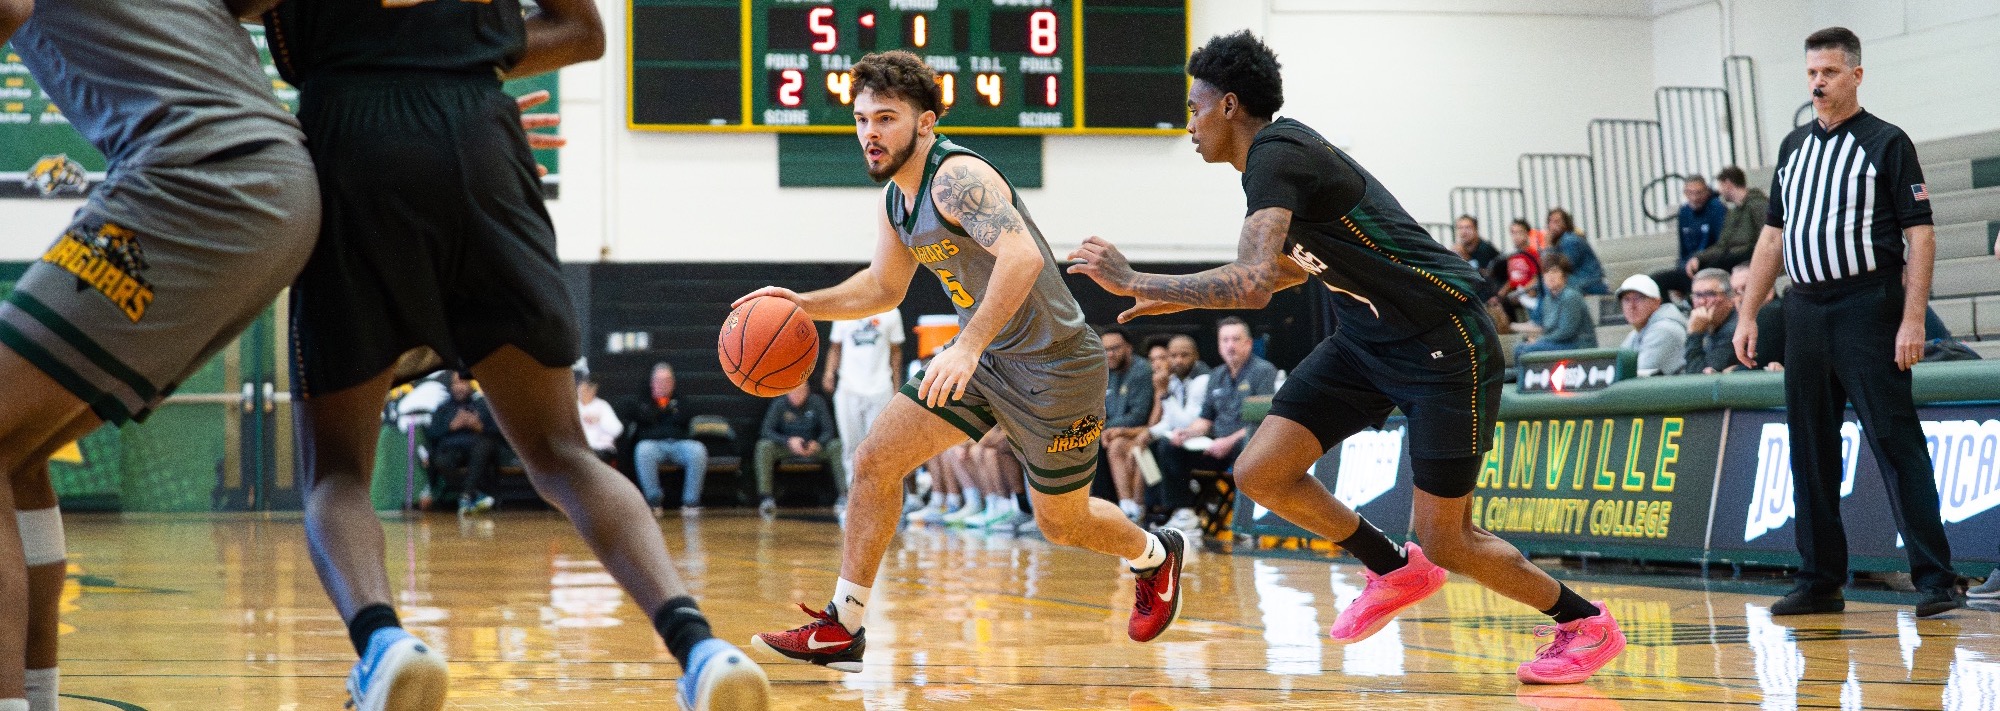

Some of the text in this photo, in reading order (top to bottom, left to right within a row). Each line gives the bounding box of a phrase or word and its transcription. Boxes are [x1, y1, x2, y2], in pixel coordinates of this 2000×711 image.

[808, 7, 837, 53] 5
[913, 14, 926, 48] 1
[1029, 10, 1058, 55] 8
[779, 68, 803, 107] 2
[825, 71, 853, 105] 4
[976, 73, 1001, 107] 4
[1045, 75, 1057, 106] 1
[935, 267, 976, 309] 5
[1475, 417, 1685, 492] ANVILLE
[1485, 496, 1590, 535] COMMUNITY
[1589, 498, 1673, 539] COLLEGE
